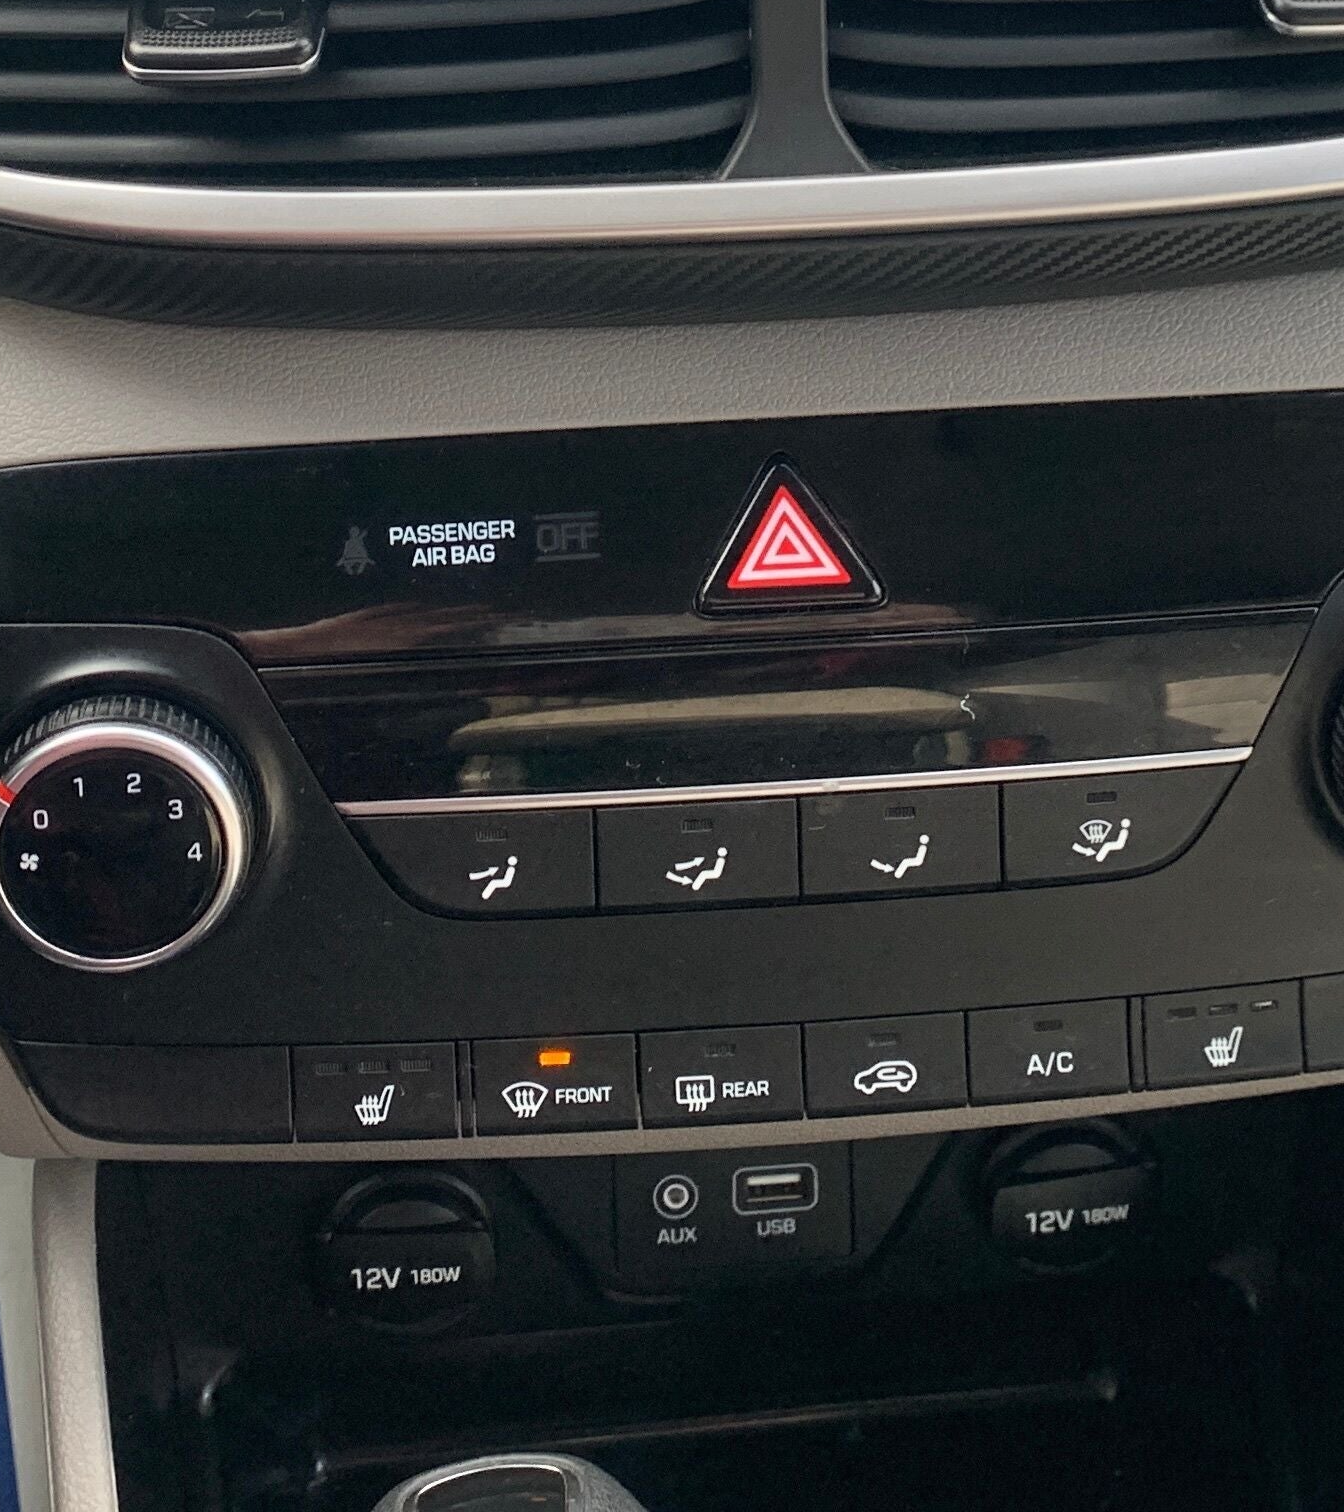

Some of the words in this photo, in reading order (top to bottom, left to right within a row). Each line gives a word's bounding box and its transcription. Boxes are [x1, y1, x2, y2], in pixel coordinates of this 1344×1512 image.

[389, 520, 515, 545] PASSENGER
[536, 522, 600, 551] OFF
[412, 546, 447, 567] AIR
[452, 544, 496, 565] BAG
[73, 777, 84, 798] 1
[127, 773, 141, 793] 2
[33, 809, 49, 830] 0
[168, 799, 183, 820] 3
[187, 842, 203, 862] 4
[1026, 1052, 1074, 1077] A/C
[555, 1086, 613, 1105] FRONT
[722, 1080, 770, 1099] REAR
[757, 1218, 796, 1237] USB
[1025, 1209, 1074, 1235] 12V
[1081, 1204, 1130, 1226] 180W
[657, 1227, 698, 1245] AUX
[351, 1267, 402, 1291] 12V
[410, 1265, 461, 1286] 180W
